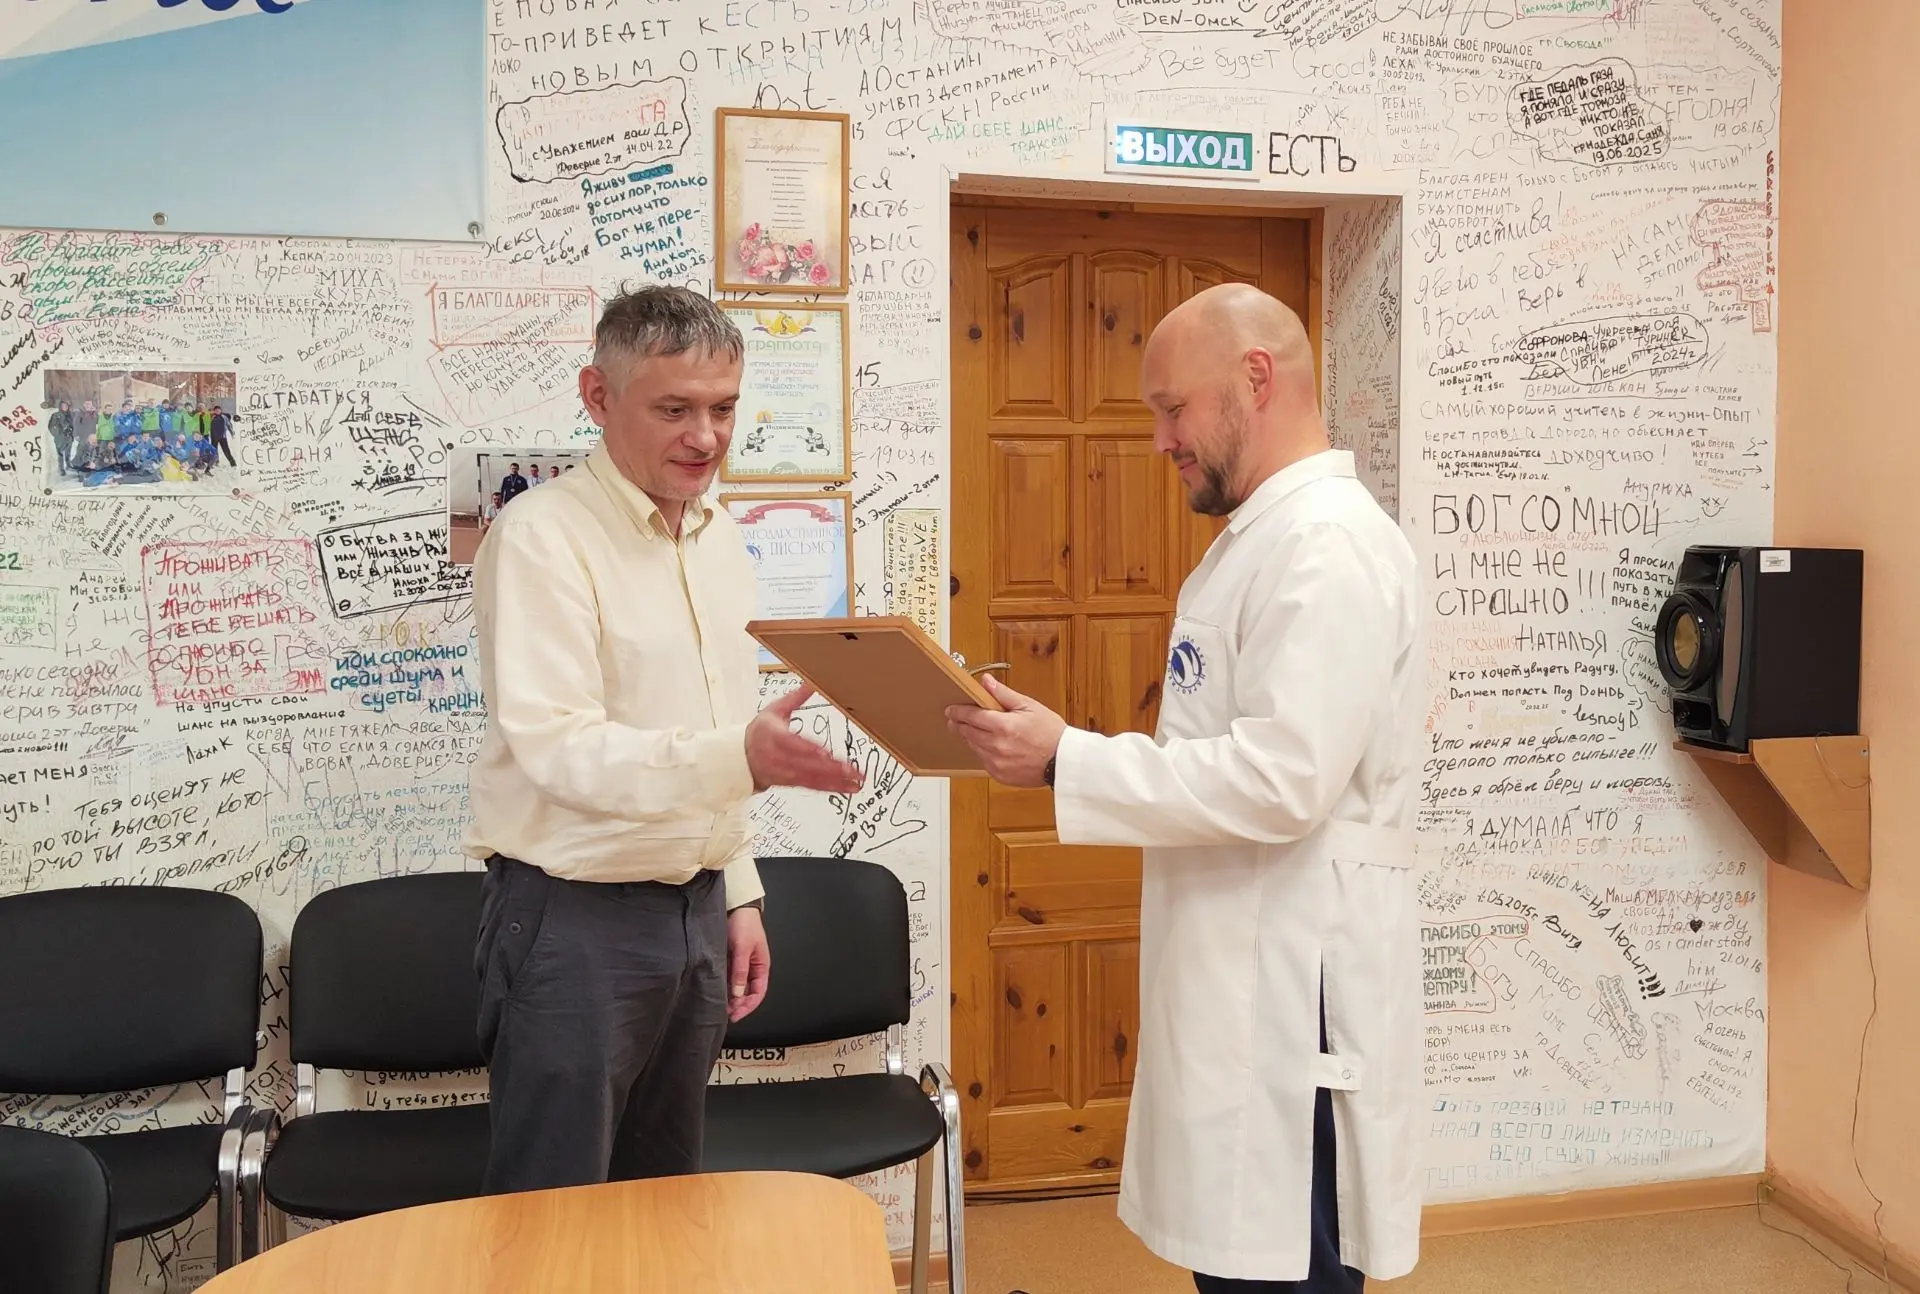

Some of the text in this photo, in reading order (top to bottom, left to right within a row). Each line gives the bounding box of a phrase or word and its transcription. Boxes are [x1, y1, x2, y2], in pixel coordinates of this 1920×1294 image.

[532, 17, 903, 91] НОВЫМ ОТКРЫТИЯМ
[1383, 31, 1397, 43] НЕ
[1401, 31, 1449, 48] ЗАБЫВАЙ
[1483, 41, 1533, 57] ПРОШЛОЕ
[1215, 46, 1282, 79] будет
[1395, 45, 1419, 56] РАДИ
[1491, 55, 1543, 71] БУДУЩЕГО
[1520, 66, 1614, 103] ГДЕ ПЕДАЛЬ ГАЗА
[1590, 77, 1626, 98] СРАЗУ
[1534, 91, 1628, 124] ВОТ ГДЕ ТОРМОЗА
[1579, 102, 1639, 127] НИКТО НЕ
[1593, 115, 1646, 137] ПОКАЗАЛ
[1122, 129, 1247, 170] ВЫХОД
[1269, 131, 1357, 177] ЕСТЬ
[1592, 146, 1663, 164] 19.06.2025
[1457, 186, 1512, 201] СТЕНАМ
[1456, 202, 1521, 217] ПОМНИТЬ
[319, 268, 386, 288] МИХА
[437, 290, 551, 311] Я БЛАГОДАРЕН
[440, 347, 468, 372] ВСЕ
[1433, 493, 1660, 537] БОГ СО МНОЙ
[340, 530, 425, 548] БИТВА ЗА
[769, 540, 837, 556] ПИСЬМО
[154, 548, 284, 579] ПРОЖИВАТЬ
[334, 546, 421, 563] ИЛИ ЖИЗНЬ
[1435, 552, 1457, 580] И
[1618, 547, 1629, 565] Я
[383, 561, 430, 575] НАШИХ
[168, 581, 202, 597] ИЛИ
[1435, 586, 1569, 617] СТРАШНО
[380, 643, 468, 666] спокойно
[330, 670, 382, 691] среди
[340, 740, 375, 754] ЕСЛИ
[1430, 731, 1464, 754] Что
[33, 764, 89, 781] МЕНЯ
[1423, 751, 1566, 780] сделало только
[1420, 780, 1468, 808] Здесь
[74, 797, 124, 822] Тебя
[1463, 818, 1474, 837] Я
[1479, 814, 1574, 838] ДУМАЛА
[1584, 810, 1619, 832] ЧТО
[1632, 814, 1644, 835] Я
